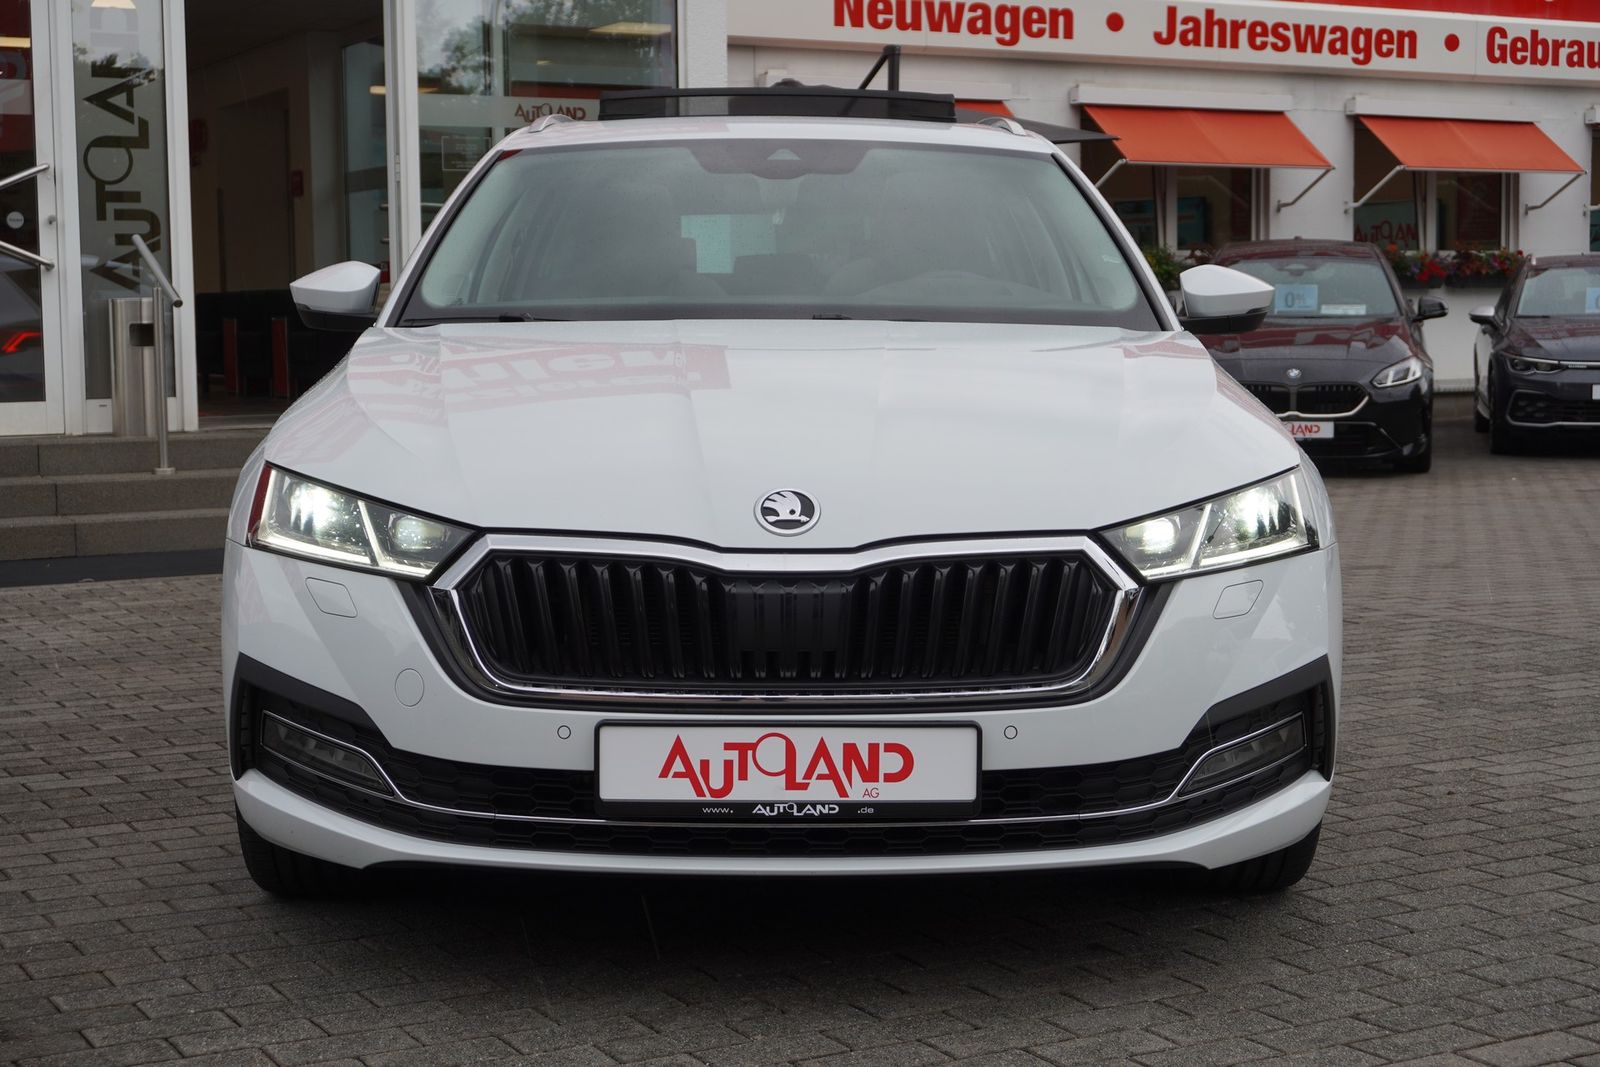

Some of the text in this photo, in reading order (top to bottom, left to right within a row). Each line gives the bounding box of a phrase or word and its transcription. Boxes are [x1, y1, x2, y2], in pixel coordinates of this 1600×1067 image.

[833, 0, 1075, 46] Neuwagen
[1153, 5, 1418, 65] Jahreswagen
[1290, 423, 1321, 436] LAND
[658, 732, 914, 799] AUTOLAND
[862, 787, 880, 798] AG
[752, 802, 839, 816] AUTOLAND
